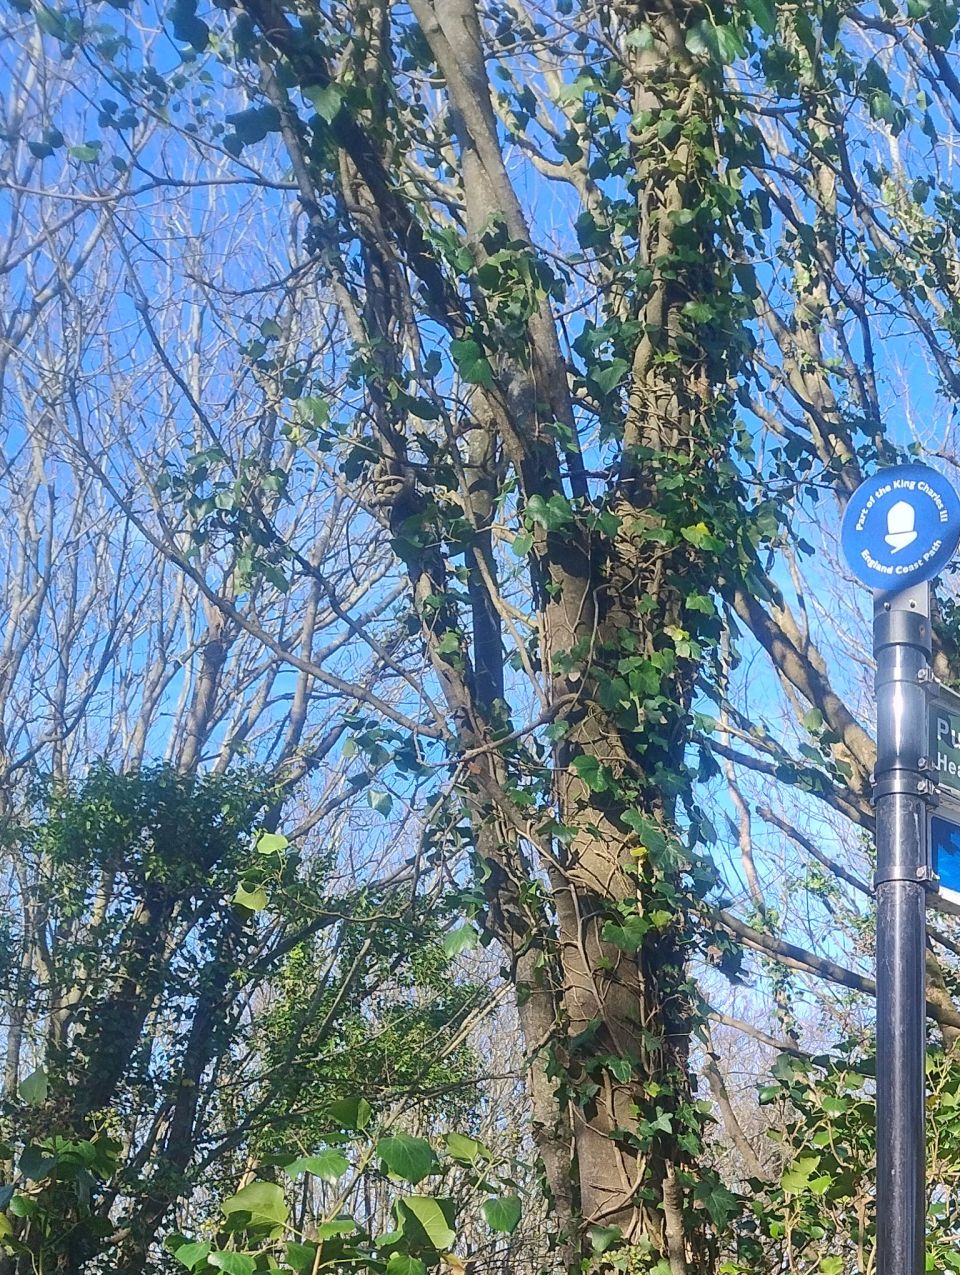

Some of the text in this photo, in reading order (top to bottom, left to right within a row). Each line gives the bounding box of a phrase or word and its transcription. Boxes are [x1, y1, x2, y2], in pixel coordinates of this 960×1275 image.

[856, 480, 948, 530] Part of the King Charles III
[861, 540, 941, 574] England Coast Path
